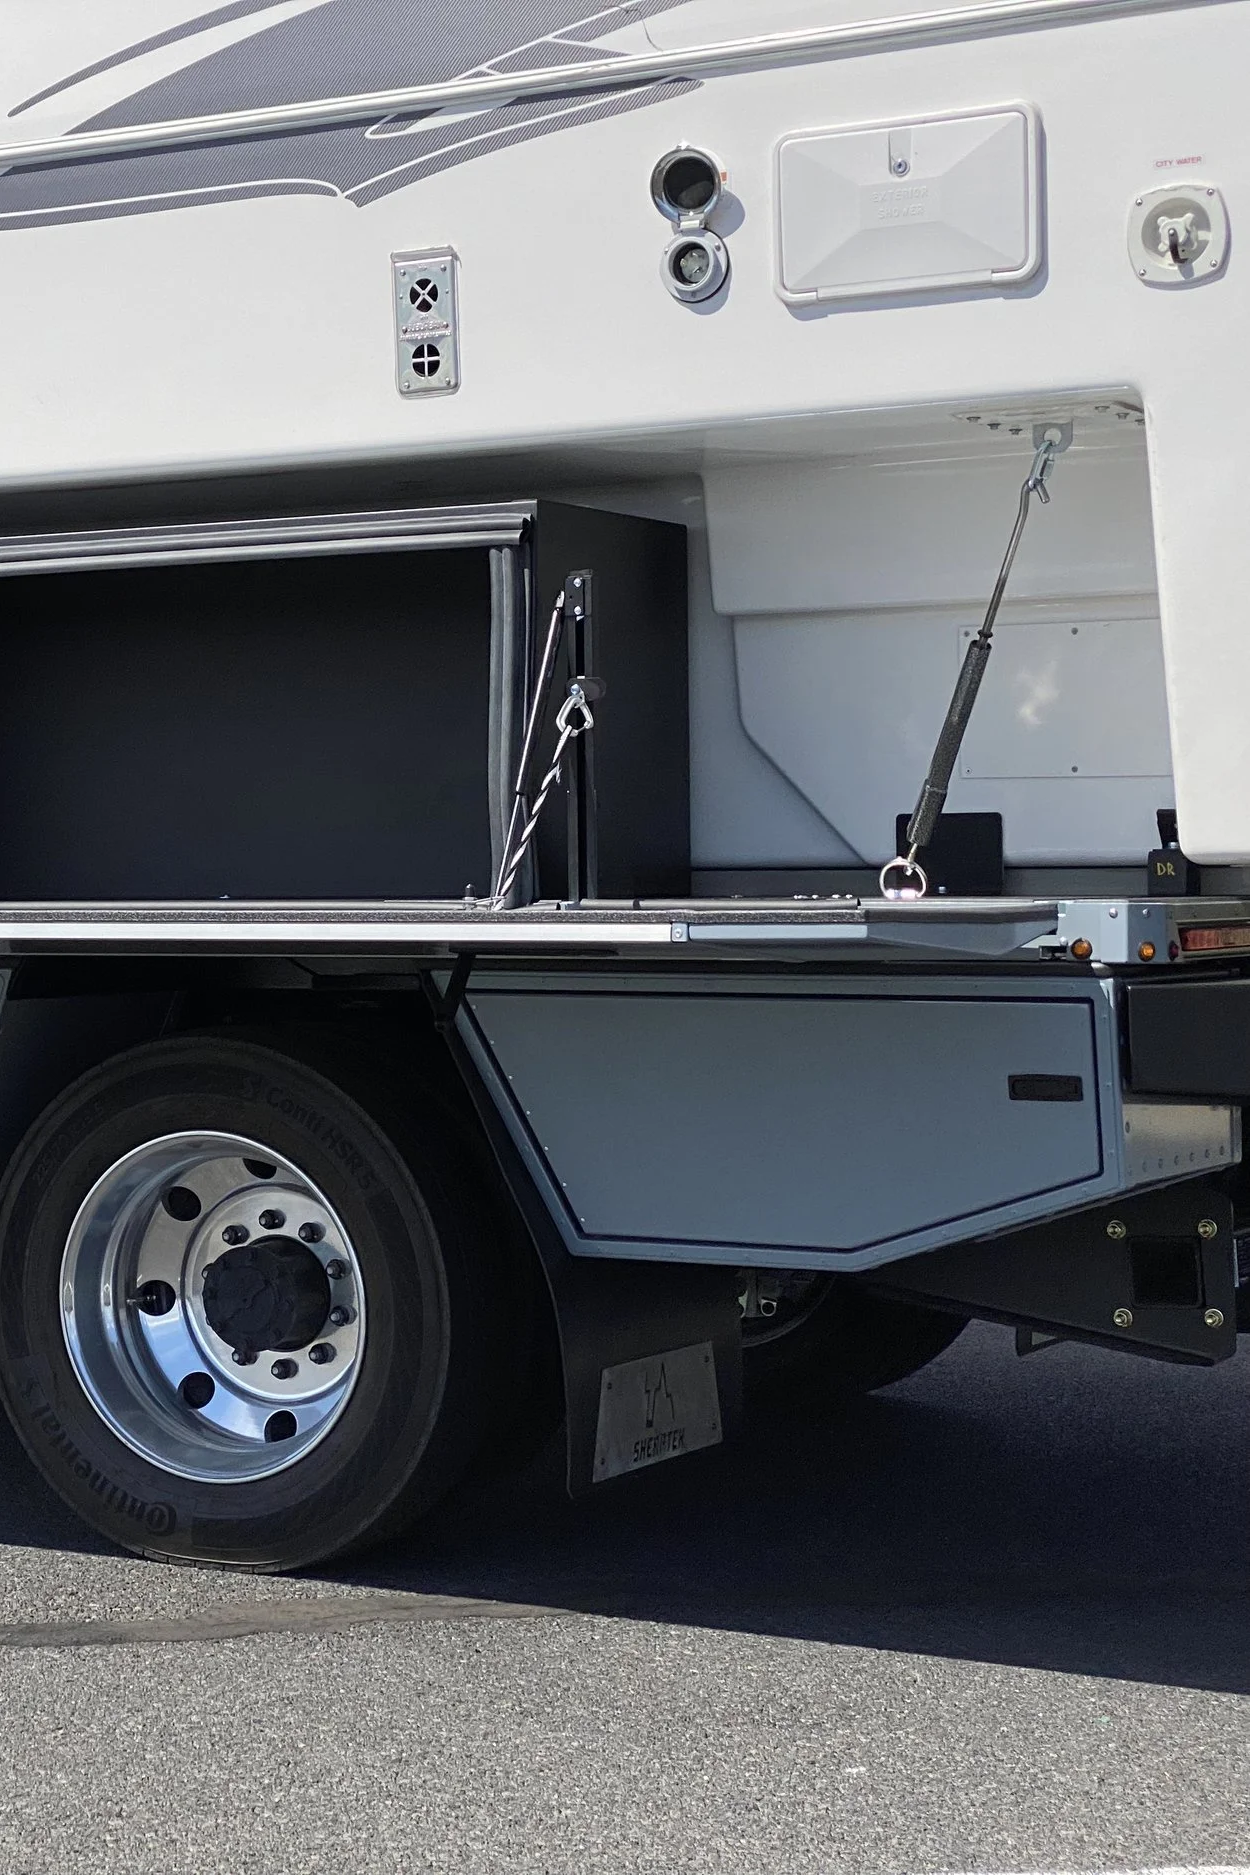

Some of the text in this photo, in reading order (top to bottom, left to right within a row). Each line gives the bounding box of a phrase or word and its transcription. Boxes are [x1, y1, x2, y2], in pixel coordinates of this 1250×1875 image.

[1155, 156, 1203, 168] CITY WATER
[870, 186, 928, 203] EXTERIOR
[877, 203, 925, 220] SHOWER
[1156, 862, 1176, 876] DR
